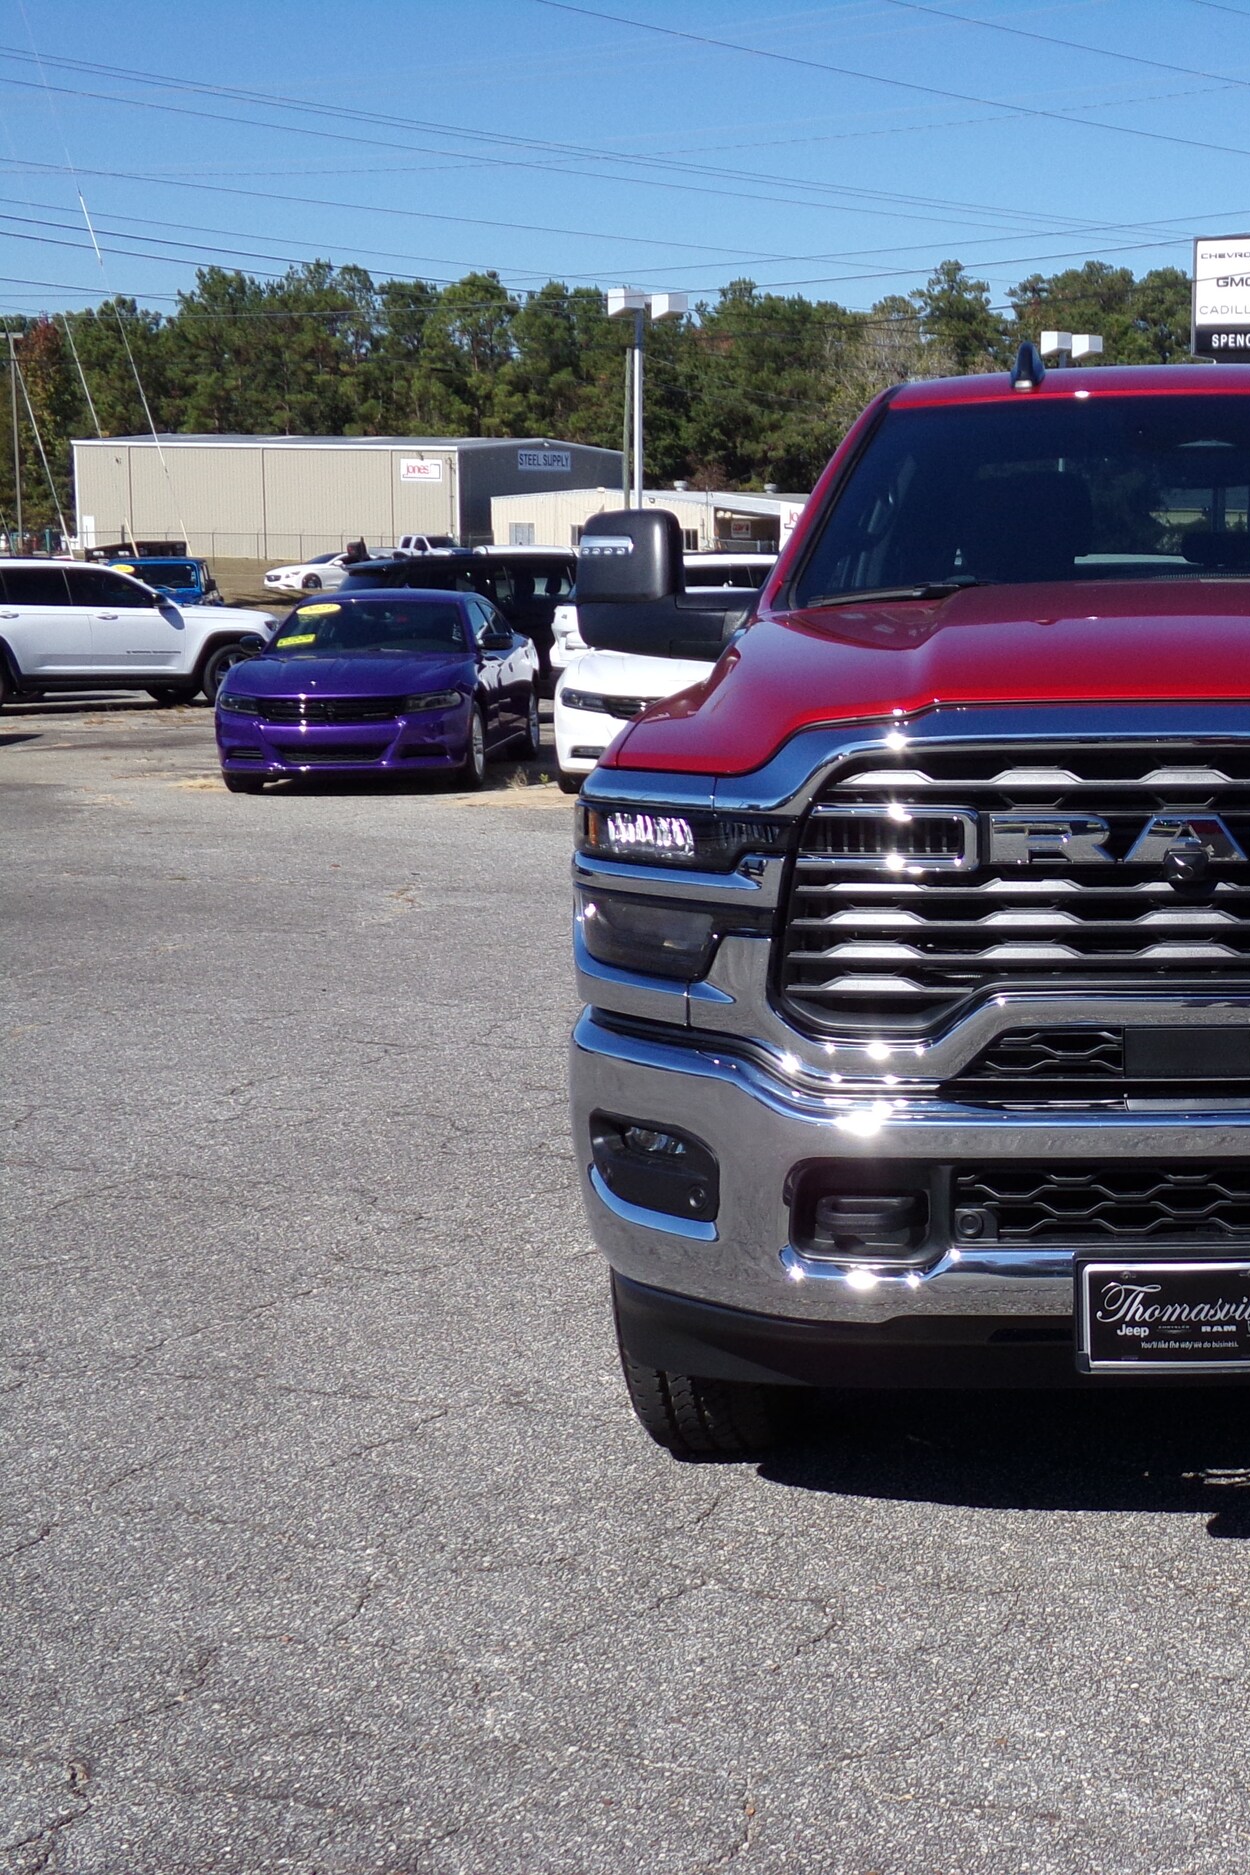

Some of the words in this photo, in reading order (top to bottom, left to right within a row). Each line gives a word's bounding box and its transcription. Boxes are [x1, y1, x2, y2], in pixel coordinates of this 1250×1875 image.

[519, 453, 541, 467] STEEL
[543, 454, 569, 468] SUPPLY
[406, 463, 429, 475] jones
[1116, 1323, 1150, 1338] Jeep
[1201, 1325, 1237, 1333] RAM
